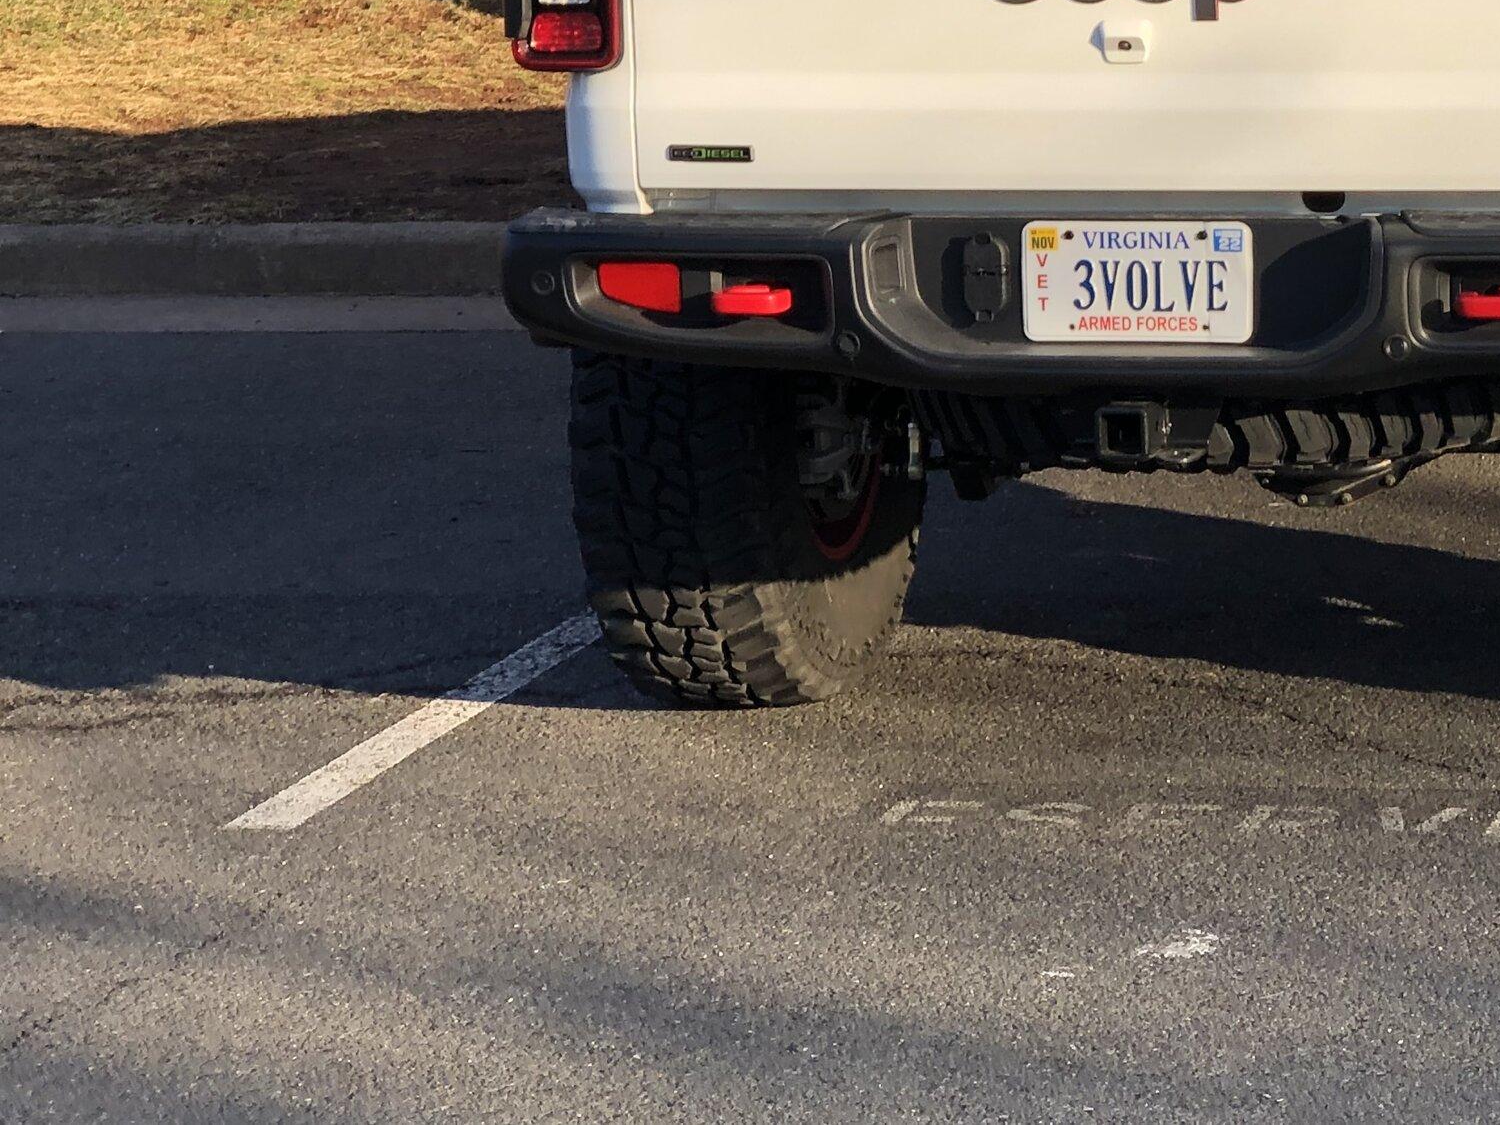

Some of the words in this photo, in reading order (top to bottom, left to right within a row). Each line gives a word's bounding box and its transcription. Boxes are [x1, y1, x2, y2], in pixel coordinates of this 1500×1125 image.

[1031, 236, 1055, 249] NOV
[1082, 231, 1190, 250] VIRGINIA
[1218, 237, 1241, 251] 22
[1072, 259, 1229, 312] 3VOLVE
[1078, 316, 1132, 332] ARMED
[1136, 316, 1198, 332] FORCES
